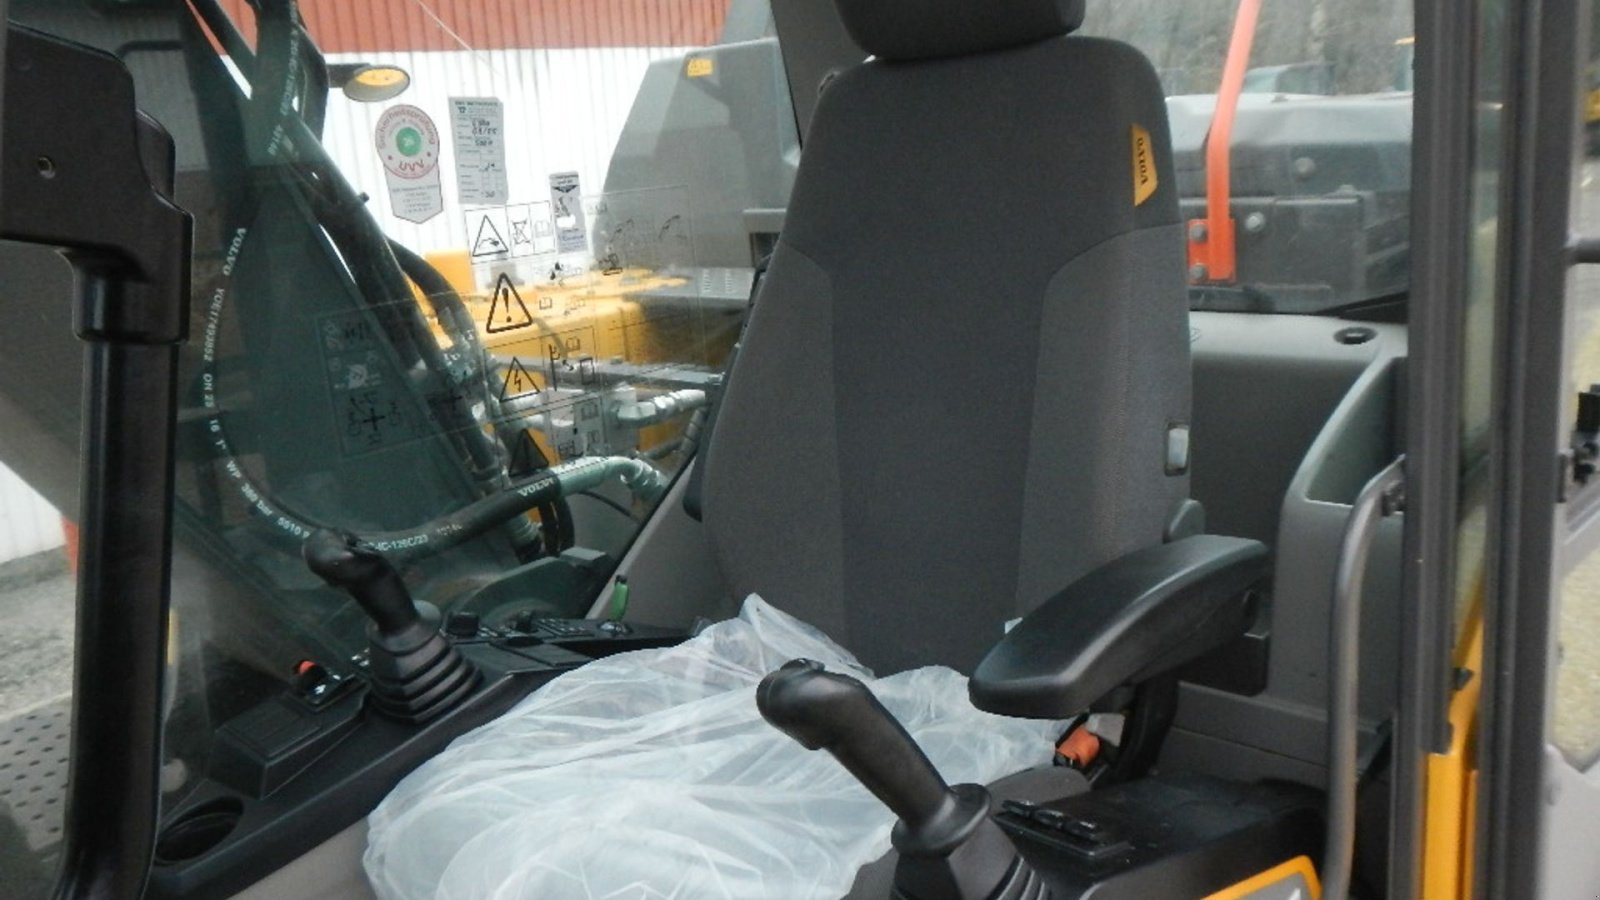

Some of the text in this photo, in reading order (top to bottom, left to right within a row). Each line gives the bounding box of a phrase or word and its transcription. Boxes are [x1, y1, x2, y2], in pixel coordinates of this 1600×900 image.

[398, 159, 425, 173] UVV
[1137, 137, 1149, 186] VOLVO
[223, 227, 247, 276] VOLVO
